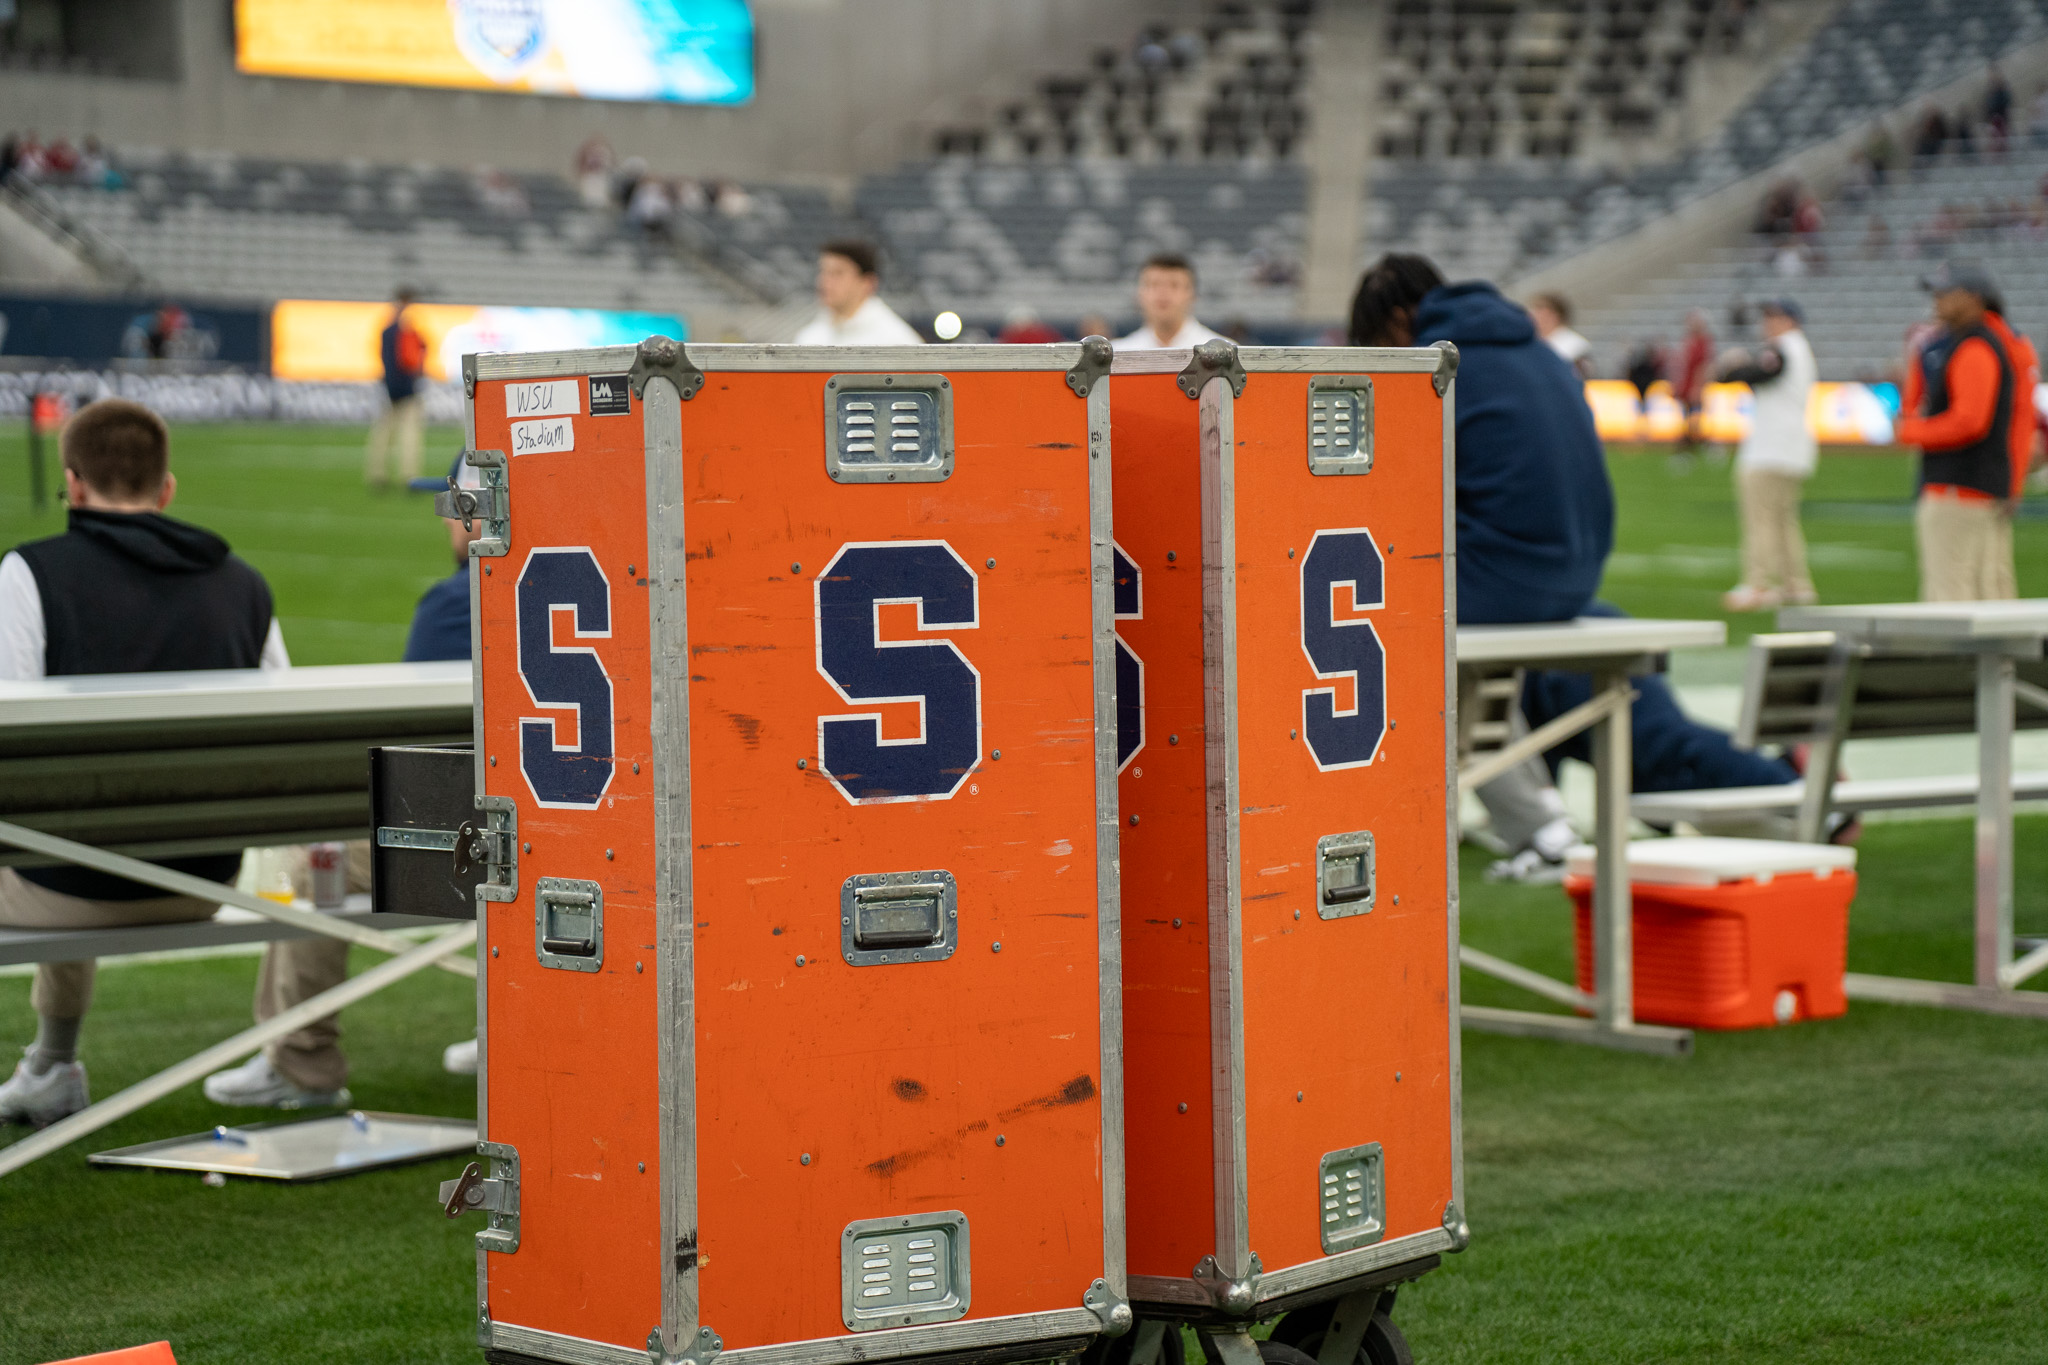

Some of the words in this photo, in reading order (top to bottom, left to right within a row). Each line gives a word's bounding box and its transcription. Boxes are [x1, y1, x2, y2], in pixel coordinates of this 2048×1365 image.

[517, 384, 553, 413] WSU
[517, 423, 563, 450] Stadium
[592, 382, 613, 398] LM
[515, 546, 615, 810] S
[814, 539, 982, 806] S
[1301, 527, 1387, 772] S
